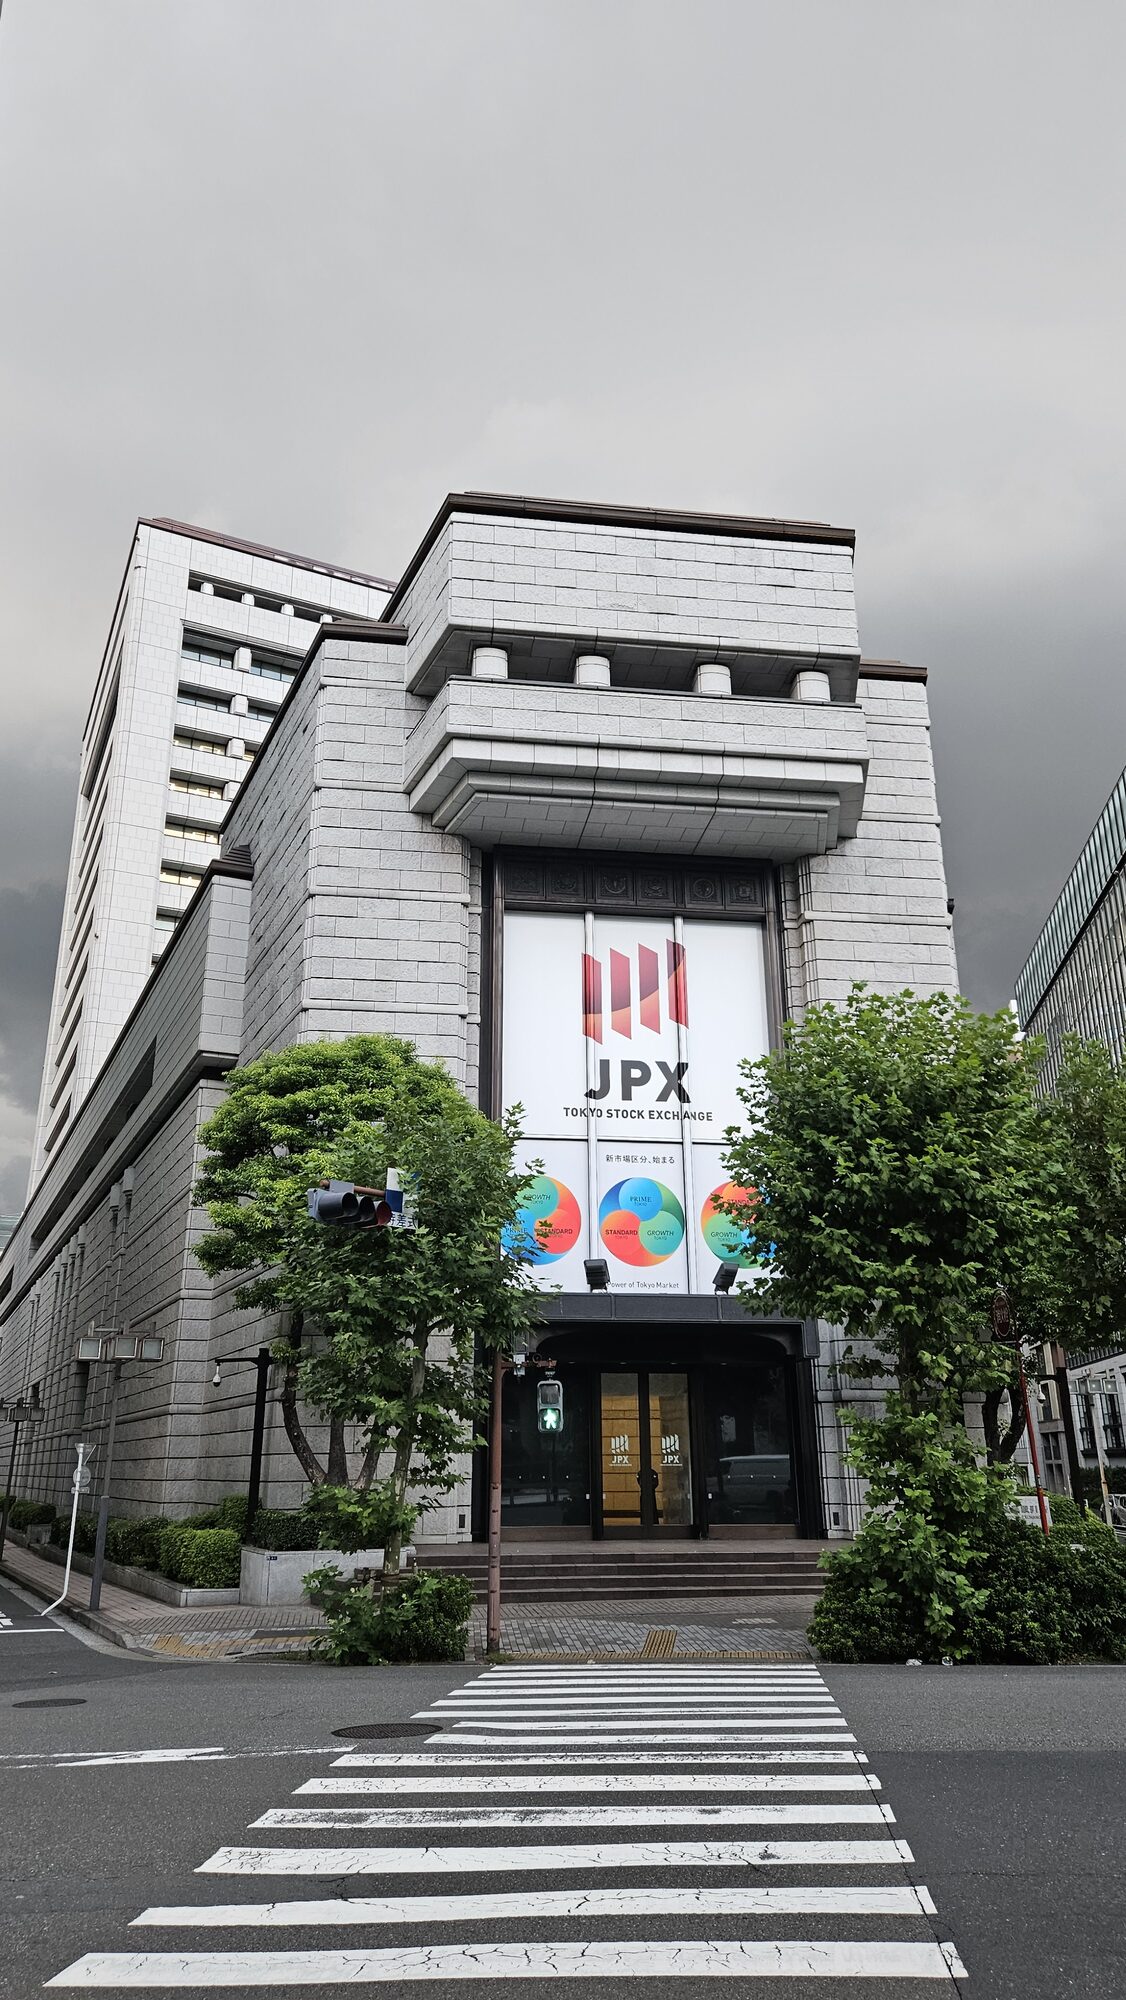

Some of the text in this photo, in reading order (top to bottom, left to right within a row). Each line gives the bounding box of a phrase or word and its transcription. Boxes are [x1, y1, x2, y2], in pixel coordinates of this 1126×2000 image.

[584, 1058, 691, 1104] JPX
[563, 1107, 713, 1122] TOKYO STOCK EXCHANGE
[605, 1154, 675, 1164] 新市場区分、始まる
[636, 1281, 655, 1290] Tokyo
[611, 1455, 629, 1464] JPX
[662, 1455, 680, 1464] JPX
